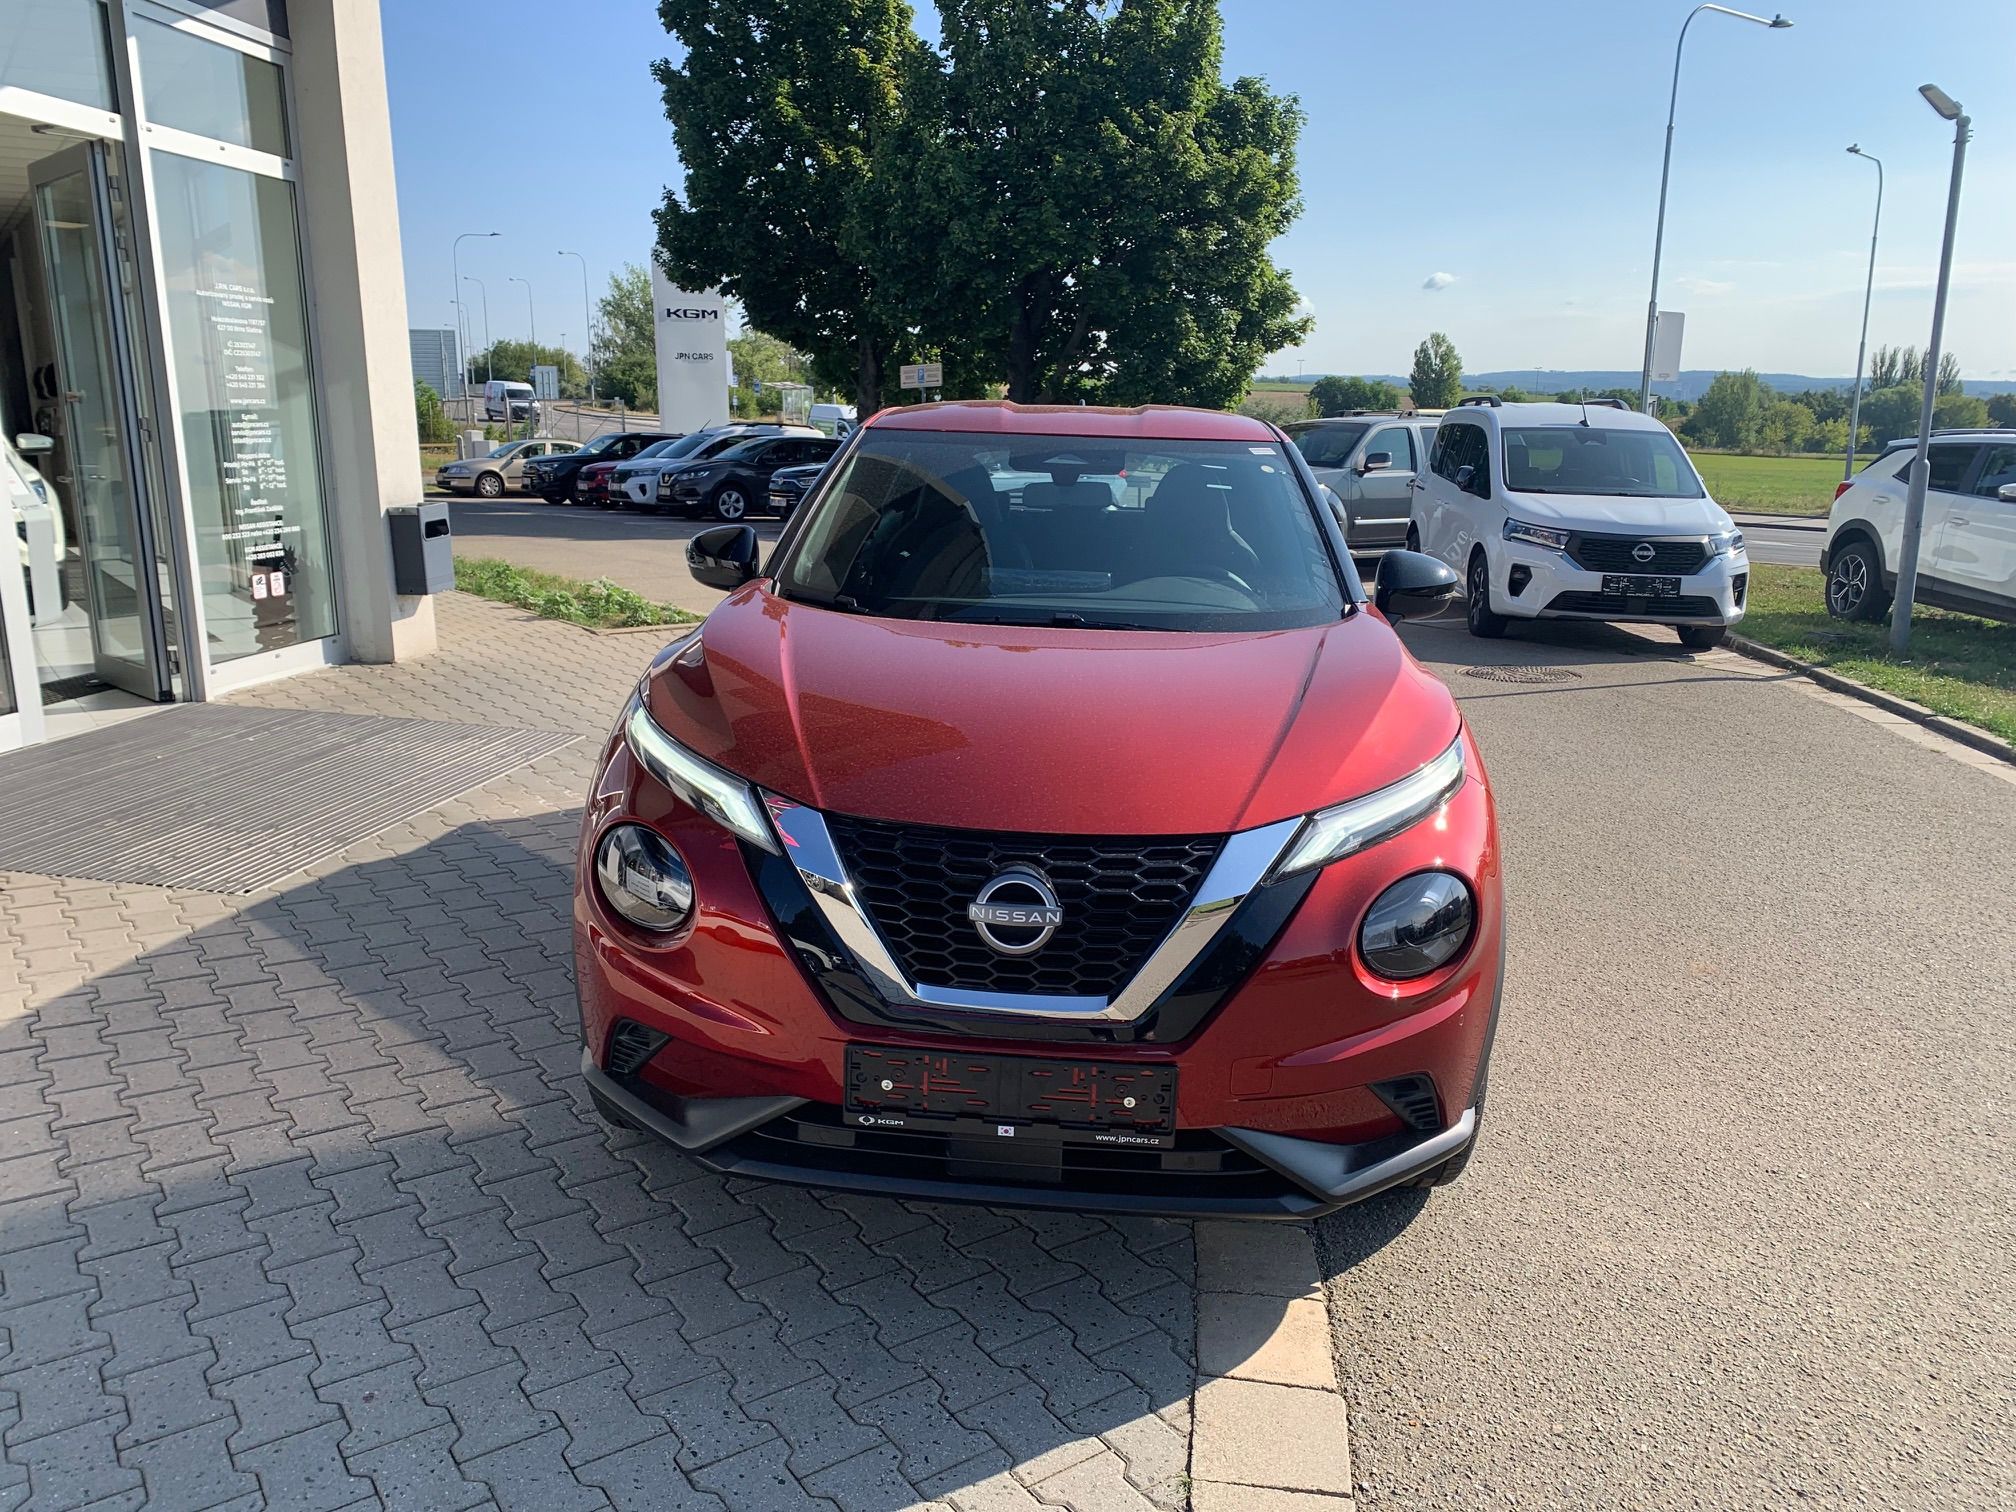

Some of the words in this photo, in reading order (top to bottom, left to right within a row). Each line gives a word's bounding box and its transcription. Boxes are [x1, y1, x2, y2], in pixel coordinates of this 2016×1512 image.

[666, 308, 718, 319] KGM
[971, 906, 1060, 923] NISSAN
[877, 1118, 904, 1126] KGM
[1095, 1134, 1160, 1145] www.jpncars.cz
